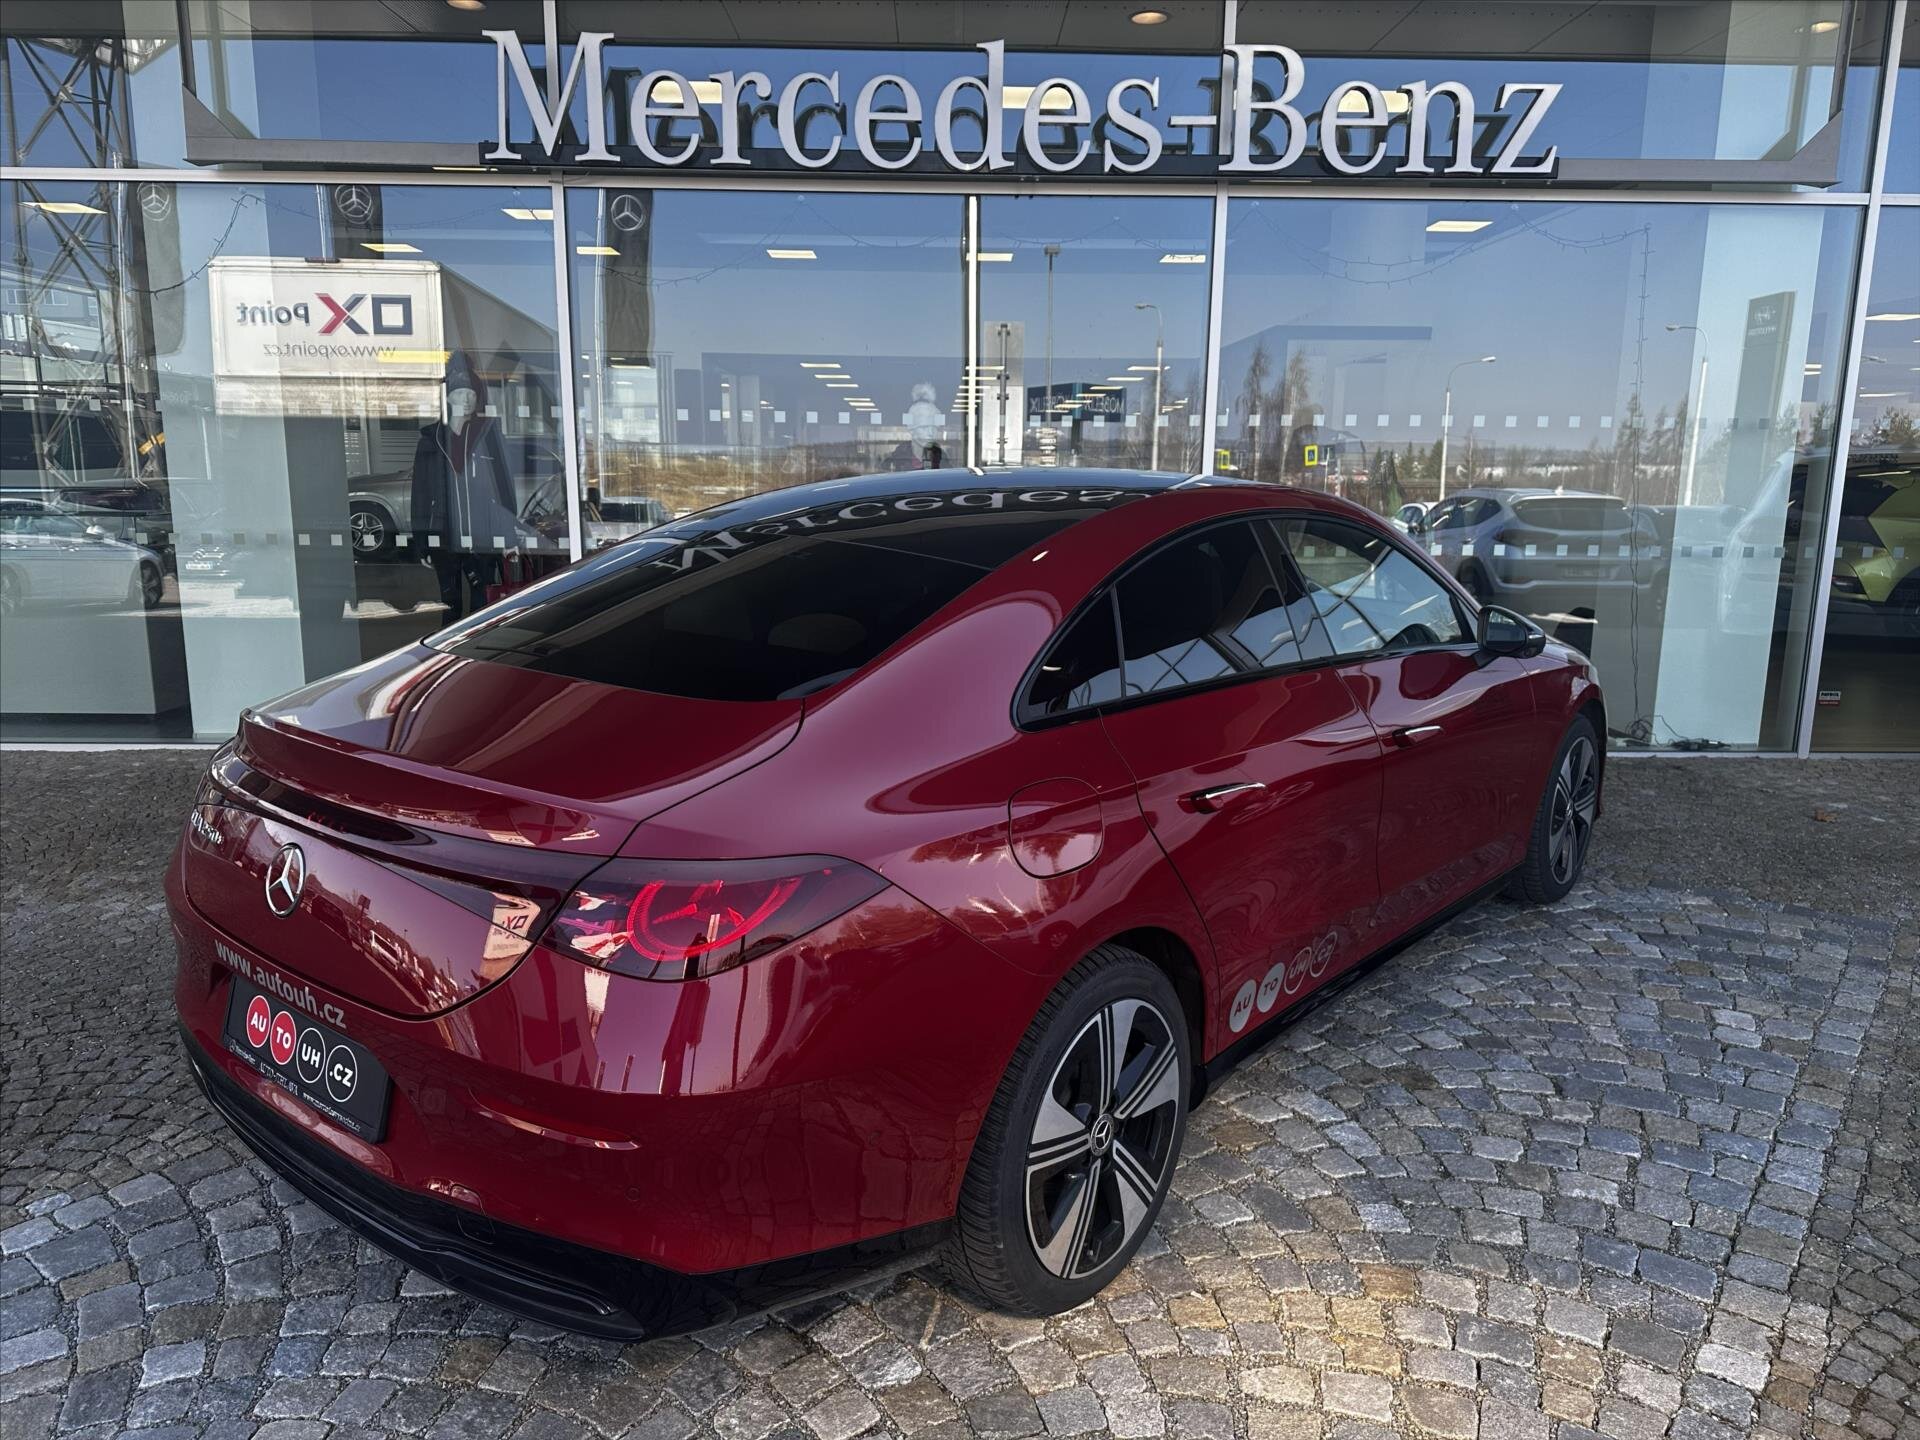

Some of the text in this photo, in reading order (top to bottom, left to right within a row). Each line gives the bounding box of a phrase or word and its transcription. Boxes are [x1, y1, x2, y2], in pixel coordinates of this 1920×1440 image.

[485, 29, 1564, 175] Mercedes-Benz
[214, 939, 347, 1029] www.autouh.cz
[1233, 993, 1252, 1018] AU
[1263, 977, 1279, 996] TO
[250, 1016, 267, 1033] AU
[276, 1026, 292, 1049] TO
[301, 1043, 321, 1069] UH
[329, 1062, 354, 1088] .CZ
